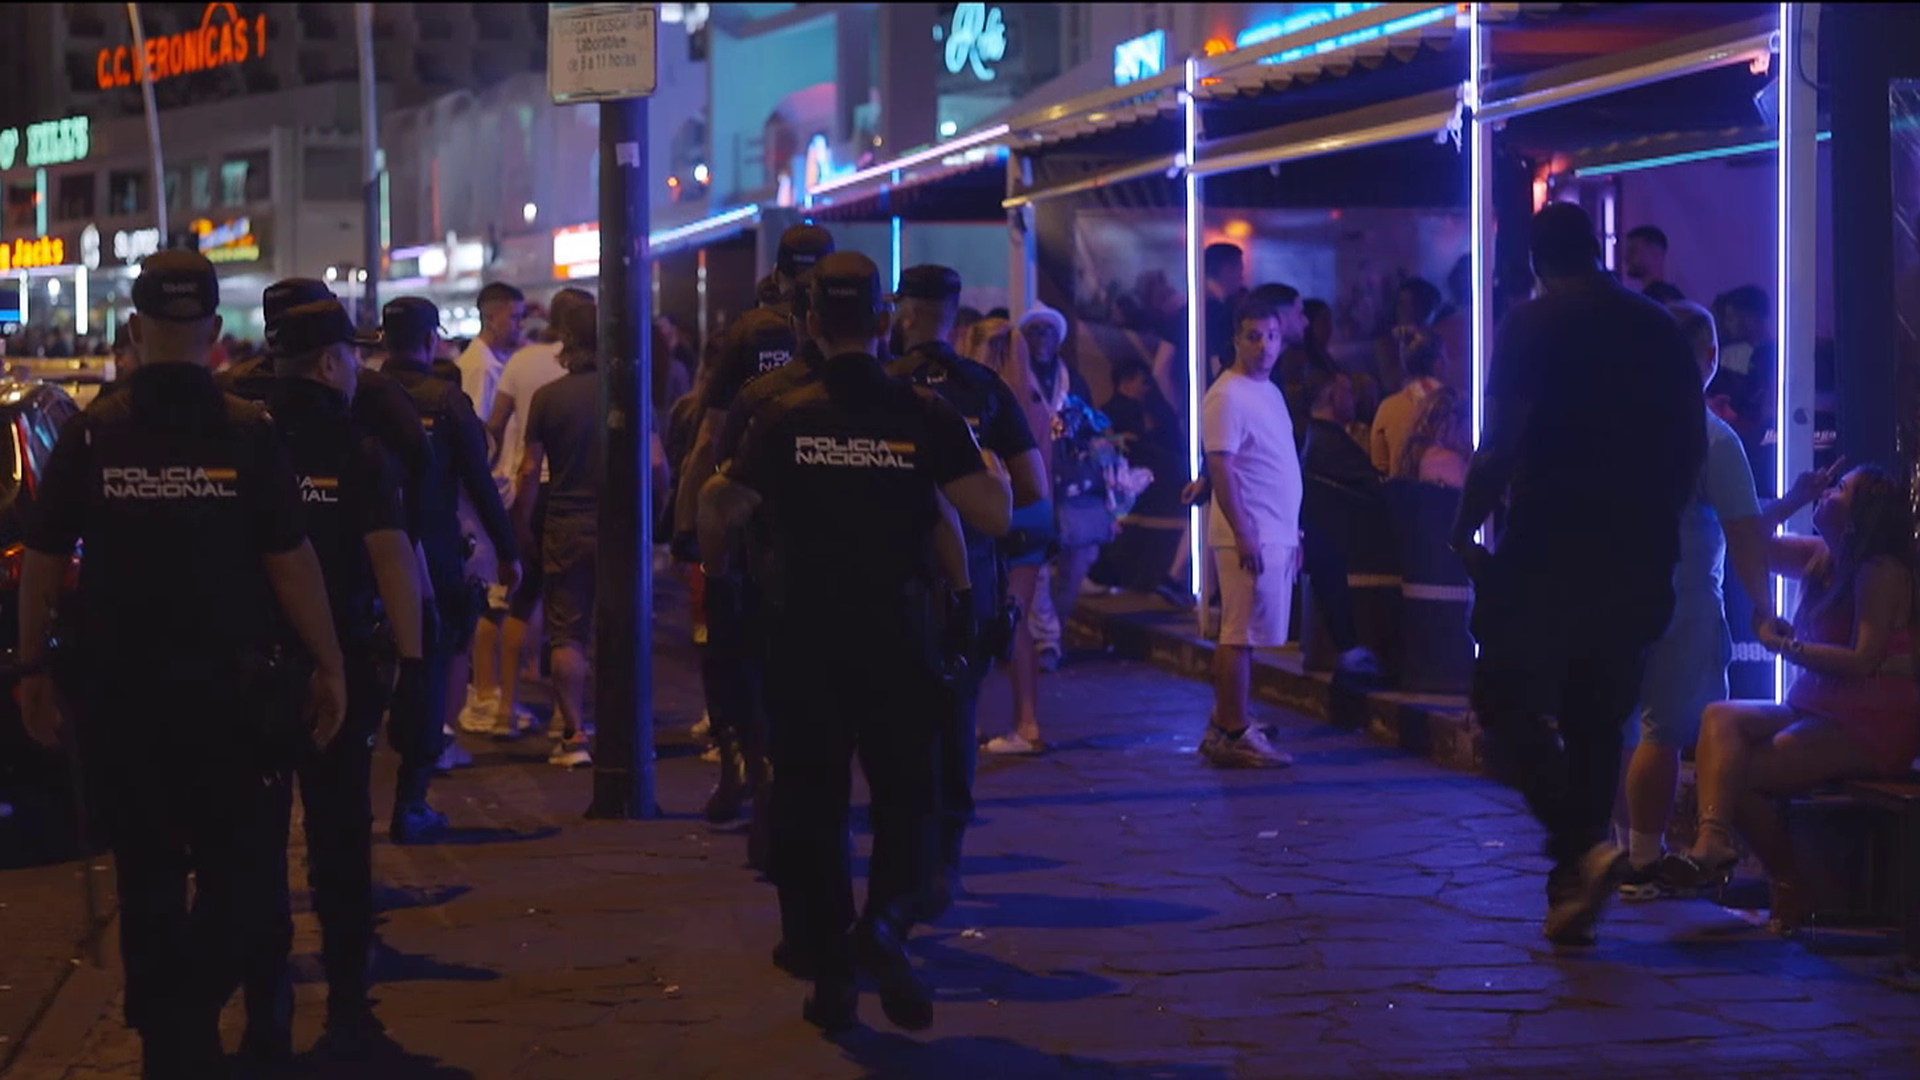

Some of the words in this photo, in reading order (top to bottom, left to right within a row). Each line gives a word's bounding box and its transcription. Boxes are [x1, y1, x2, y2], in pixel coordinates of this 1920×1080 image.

[255, 13, 266, 57] 1
[796, 436, 892, 453] POLICIA
[796, 451, 914, 468] NACIONAL
[102, 467, 209, 482] POLICIA
[103, 482, 237, 498] NACIONAL
